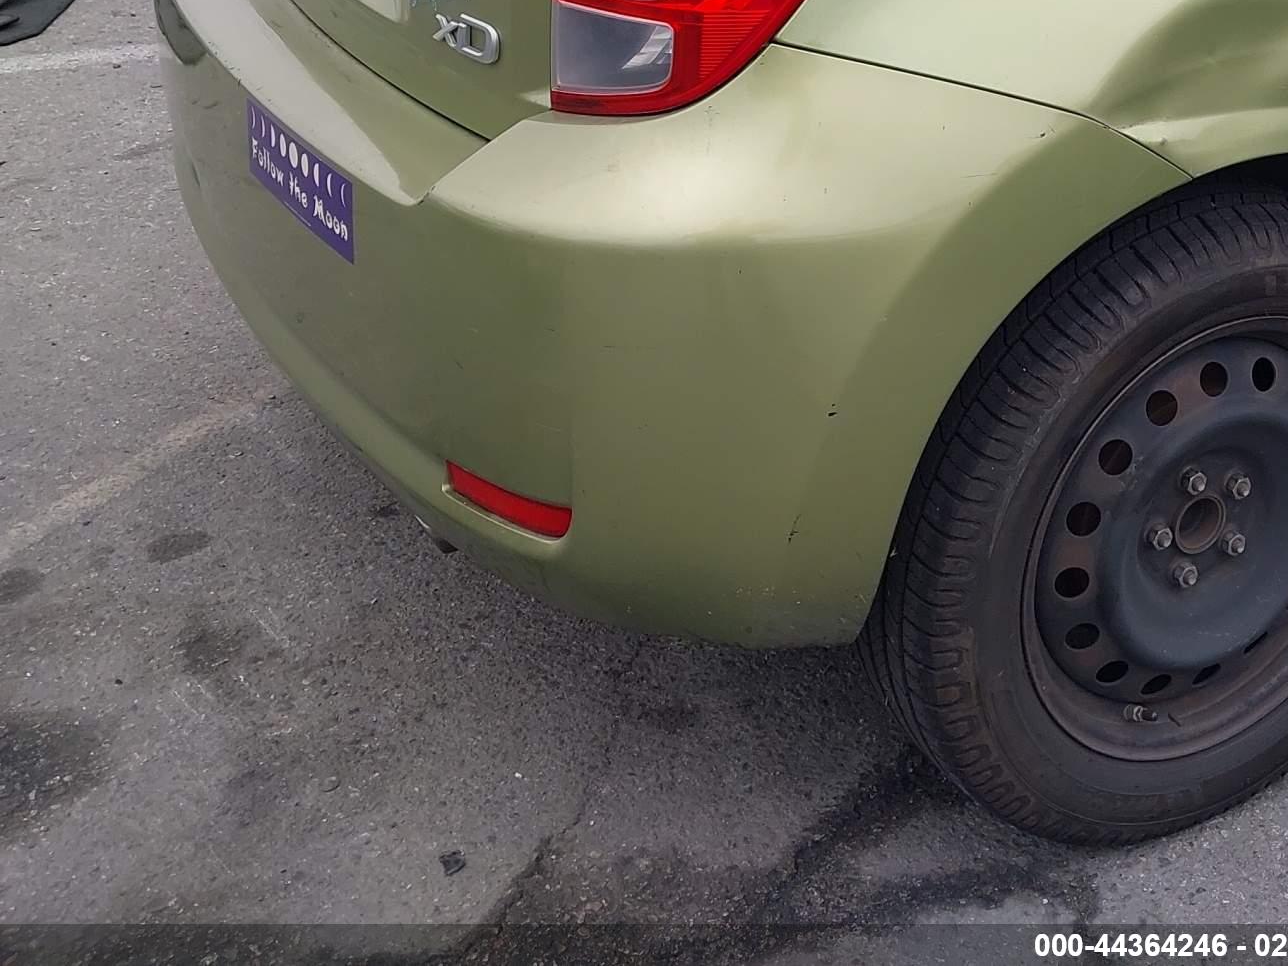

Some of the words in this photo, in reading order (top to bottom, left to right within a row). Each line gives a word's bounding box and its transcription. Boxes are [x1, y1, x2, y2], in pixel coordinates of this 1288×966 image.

[251, 137, 285, 187] Follow
[289, 172, 309, 208] the
[313, 195, 349, 242] Moon
